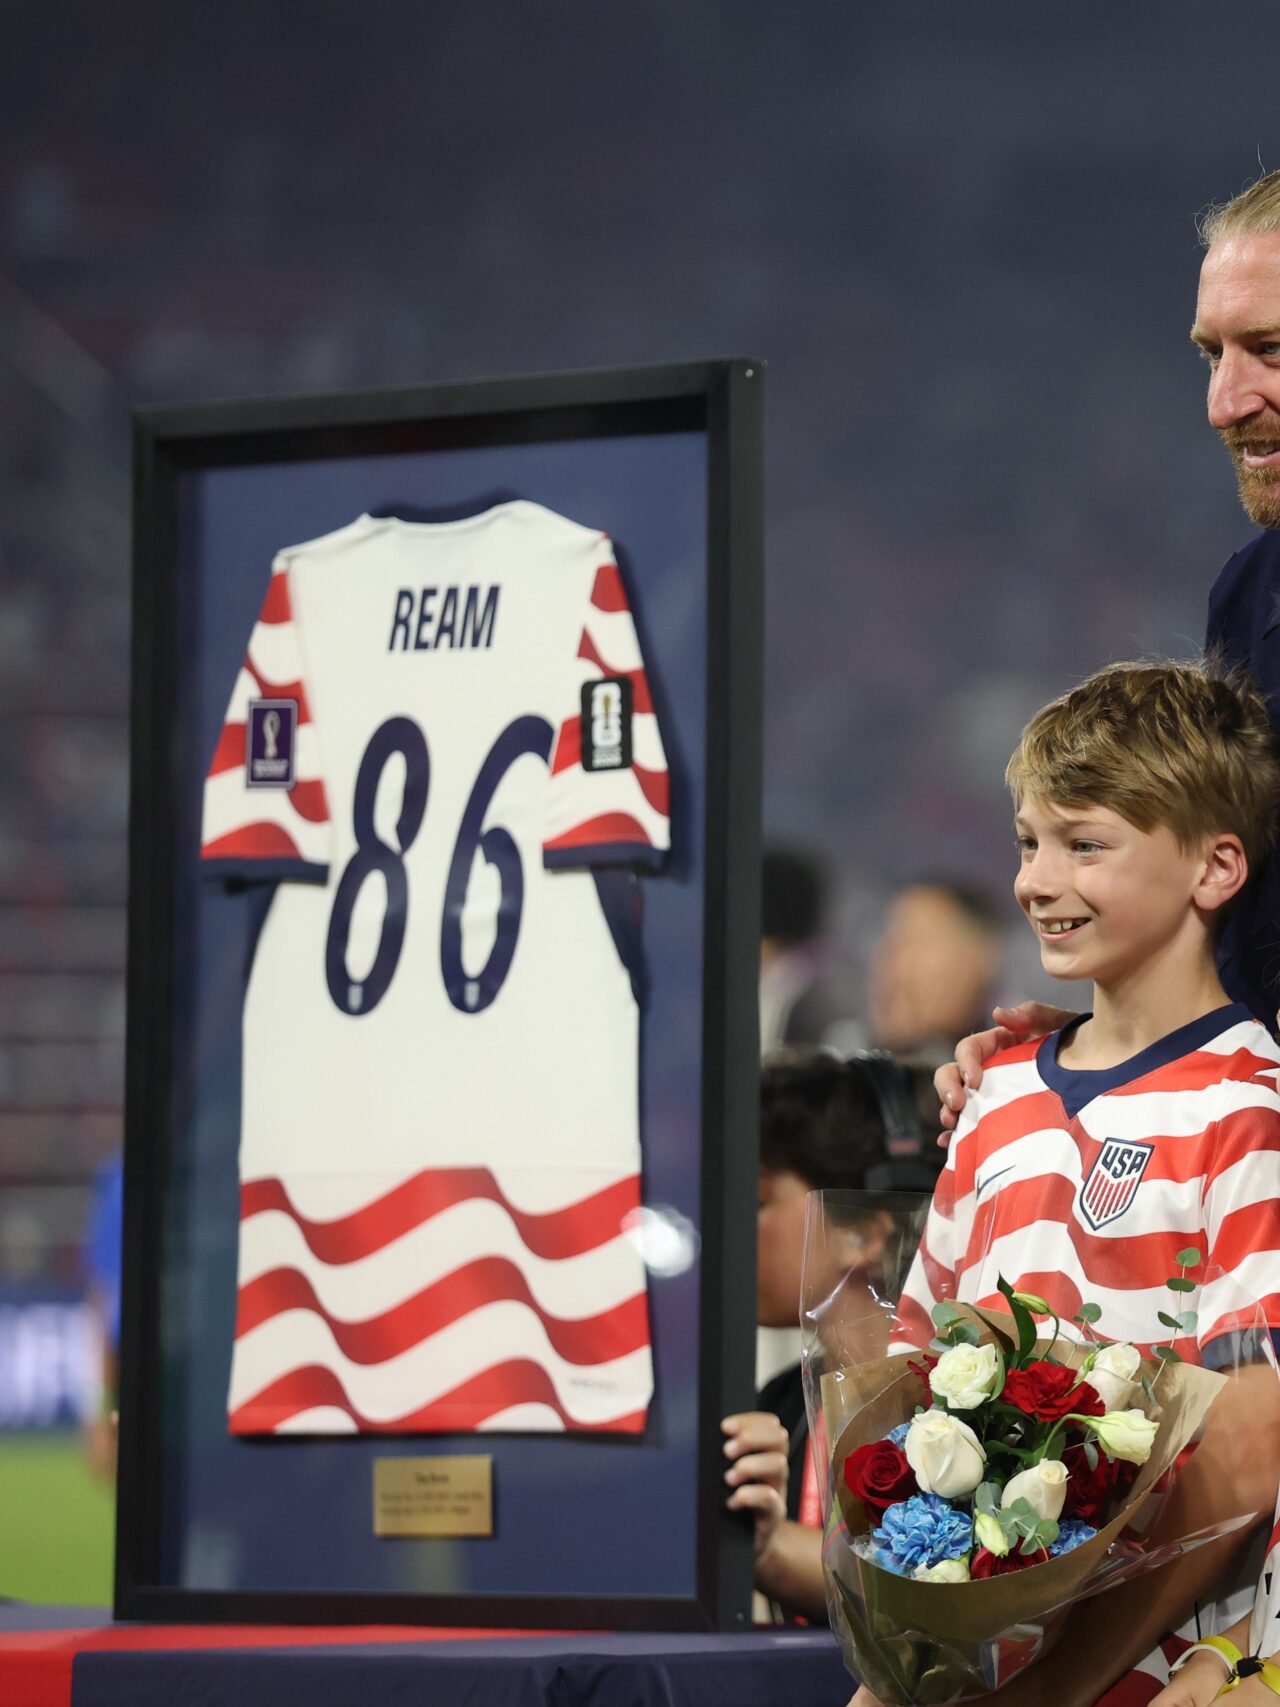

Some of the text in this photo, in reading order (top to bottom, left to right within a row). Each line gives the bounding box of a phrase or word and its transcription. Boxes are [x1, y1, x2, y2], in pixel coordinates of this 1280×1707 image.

[388, 584, 501, 652] REAM
[325, 714, 556, 1018] 86
[1101, 1145, 1147, 1179] USA
